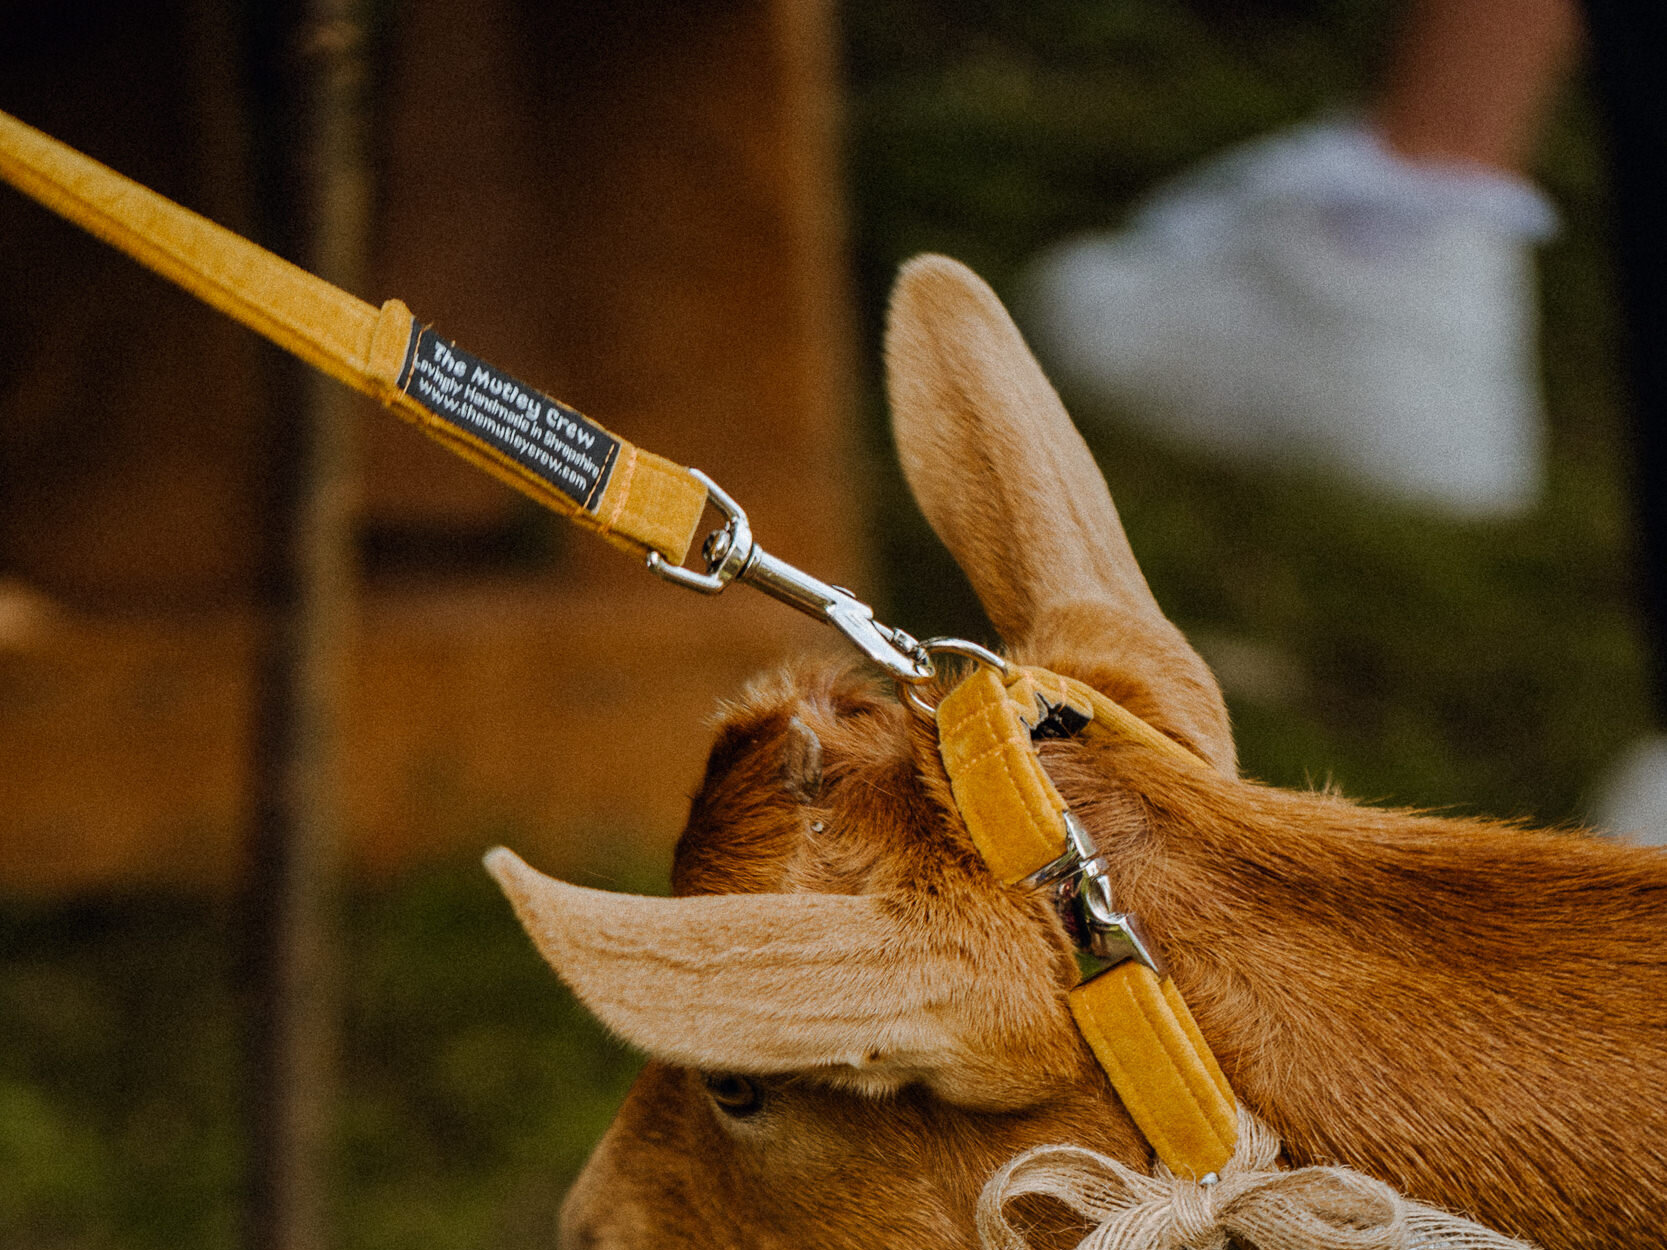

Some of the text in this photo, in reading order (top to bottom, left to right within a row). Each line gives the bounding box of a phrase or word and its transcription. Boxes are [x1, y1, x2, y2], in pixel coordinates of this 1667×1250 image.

[414, 353, 463, 396] Lovingly
[463, 384, 531, 432] Handmade
[543, 431, 600, 479] Shropshire
[419, 376, 587, 491] www.themutleycrew.com
[434, 341, 595, 449] The Mutley Crew
